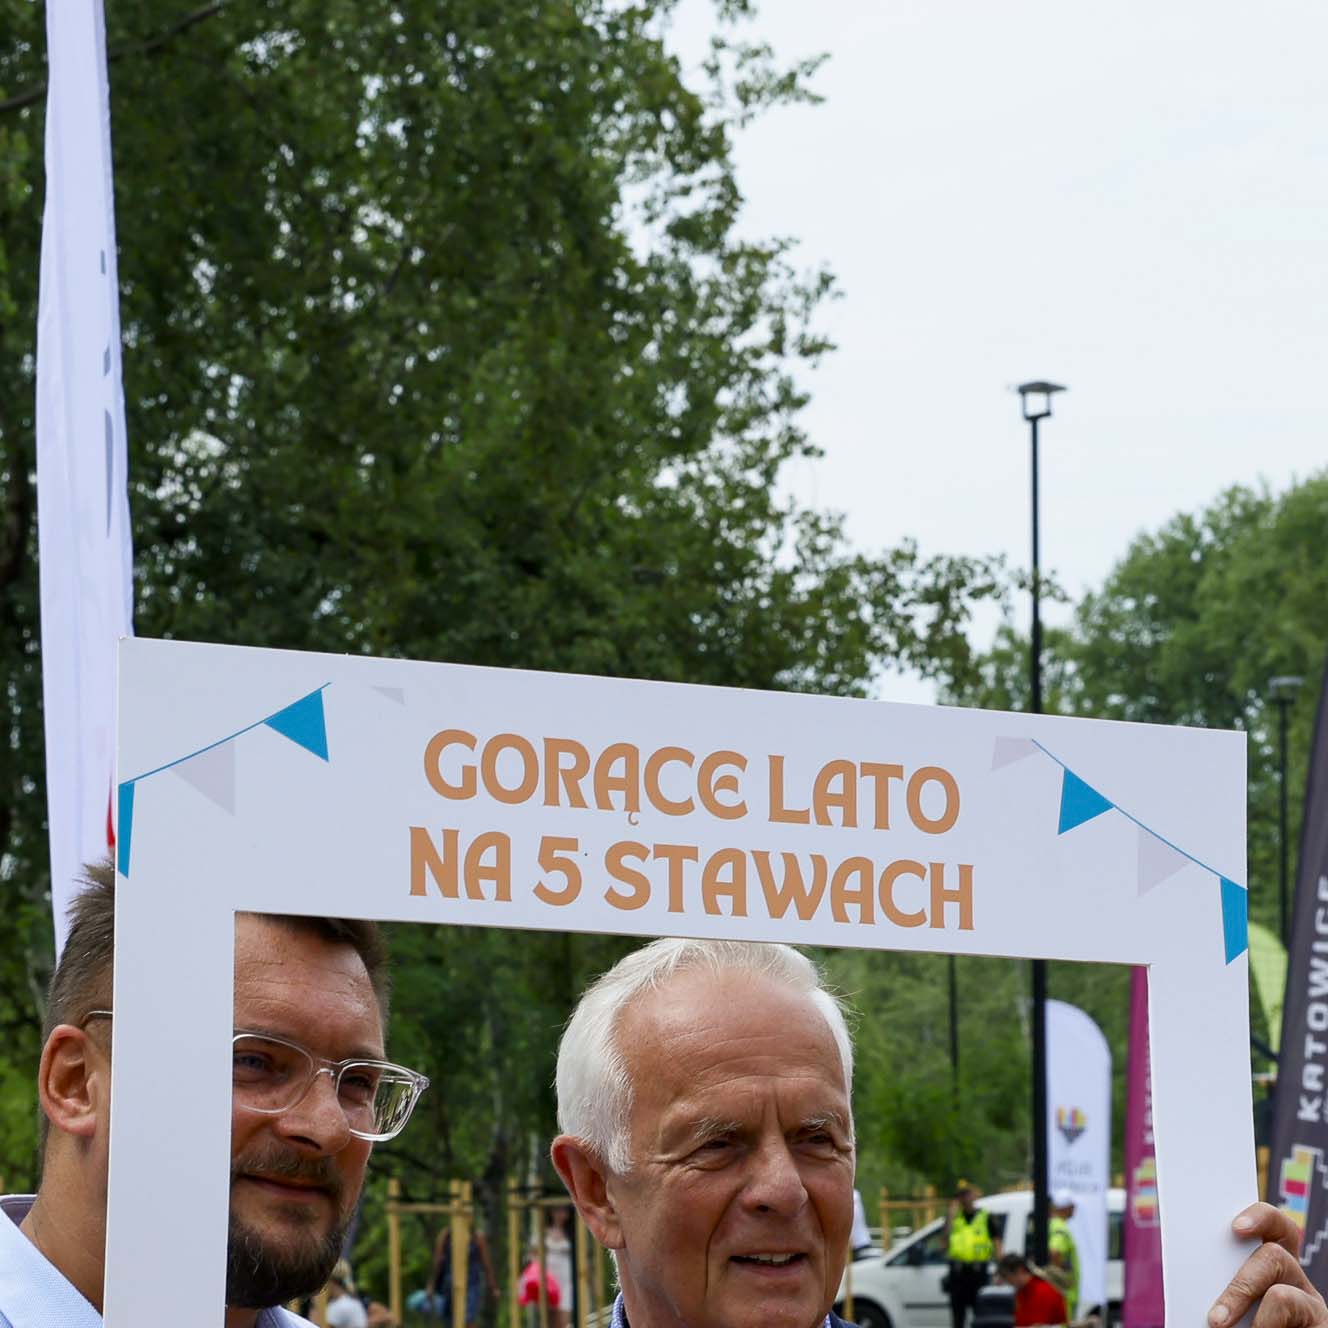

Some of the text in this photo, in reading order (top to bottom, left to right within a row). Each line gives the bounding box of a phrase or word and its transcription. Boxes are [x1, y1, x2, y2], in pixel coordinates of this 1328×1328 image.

[422, 726, 961, 835] GORĄCE LATO
[408, 826, 975, 931] NA 5 STAWACH
